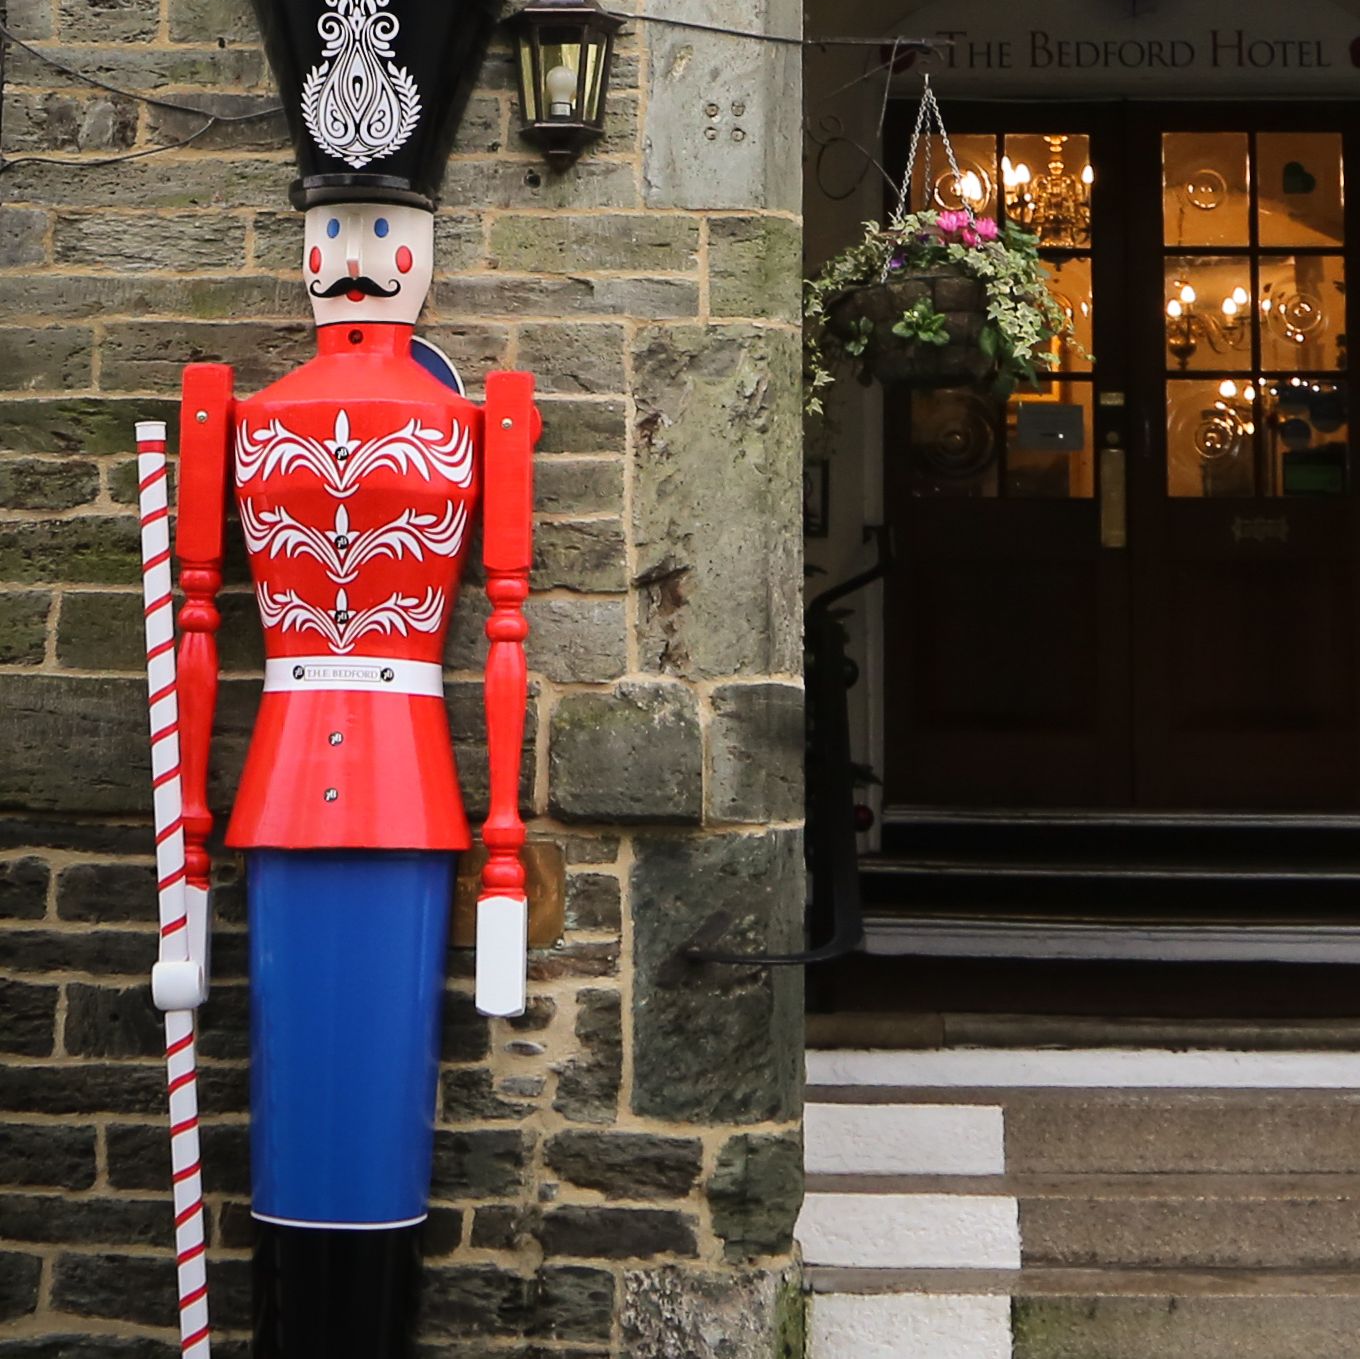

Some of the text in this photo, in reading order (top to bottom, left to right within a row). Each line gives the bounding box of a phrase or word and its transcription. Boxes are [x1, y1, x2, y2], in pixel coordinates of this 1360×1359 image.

[1028, 30, 1196, 70] BEDFORD
[1210, 30, 1333, 70] HOTEL
[332, 669, 378, 680] BEDFORD
